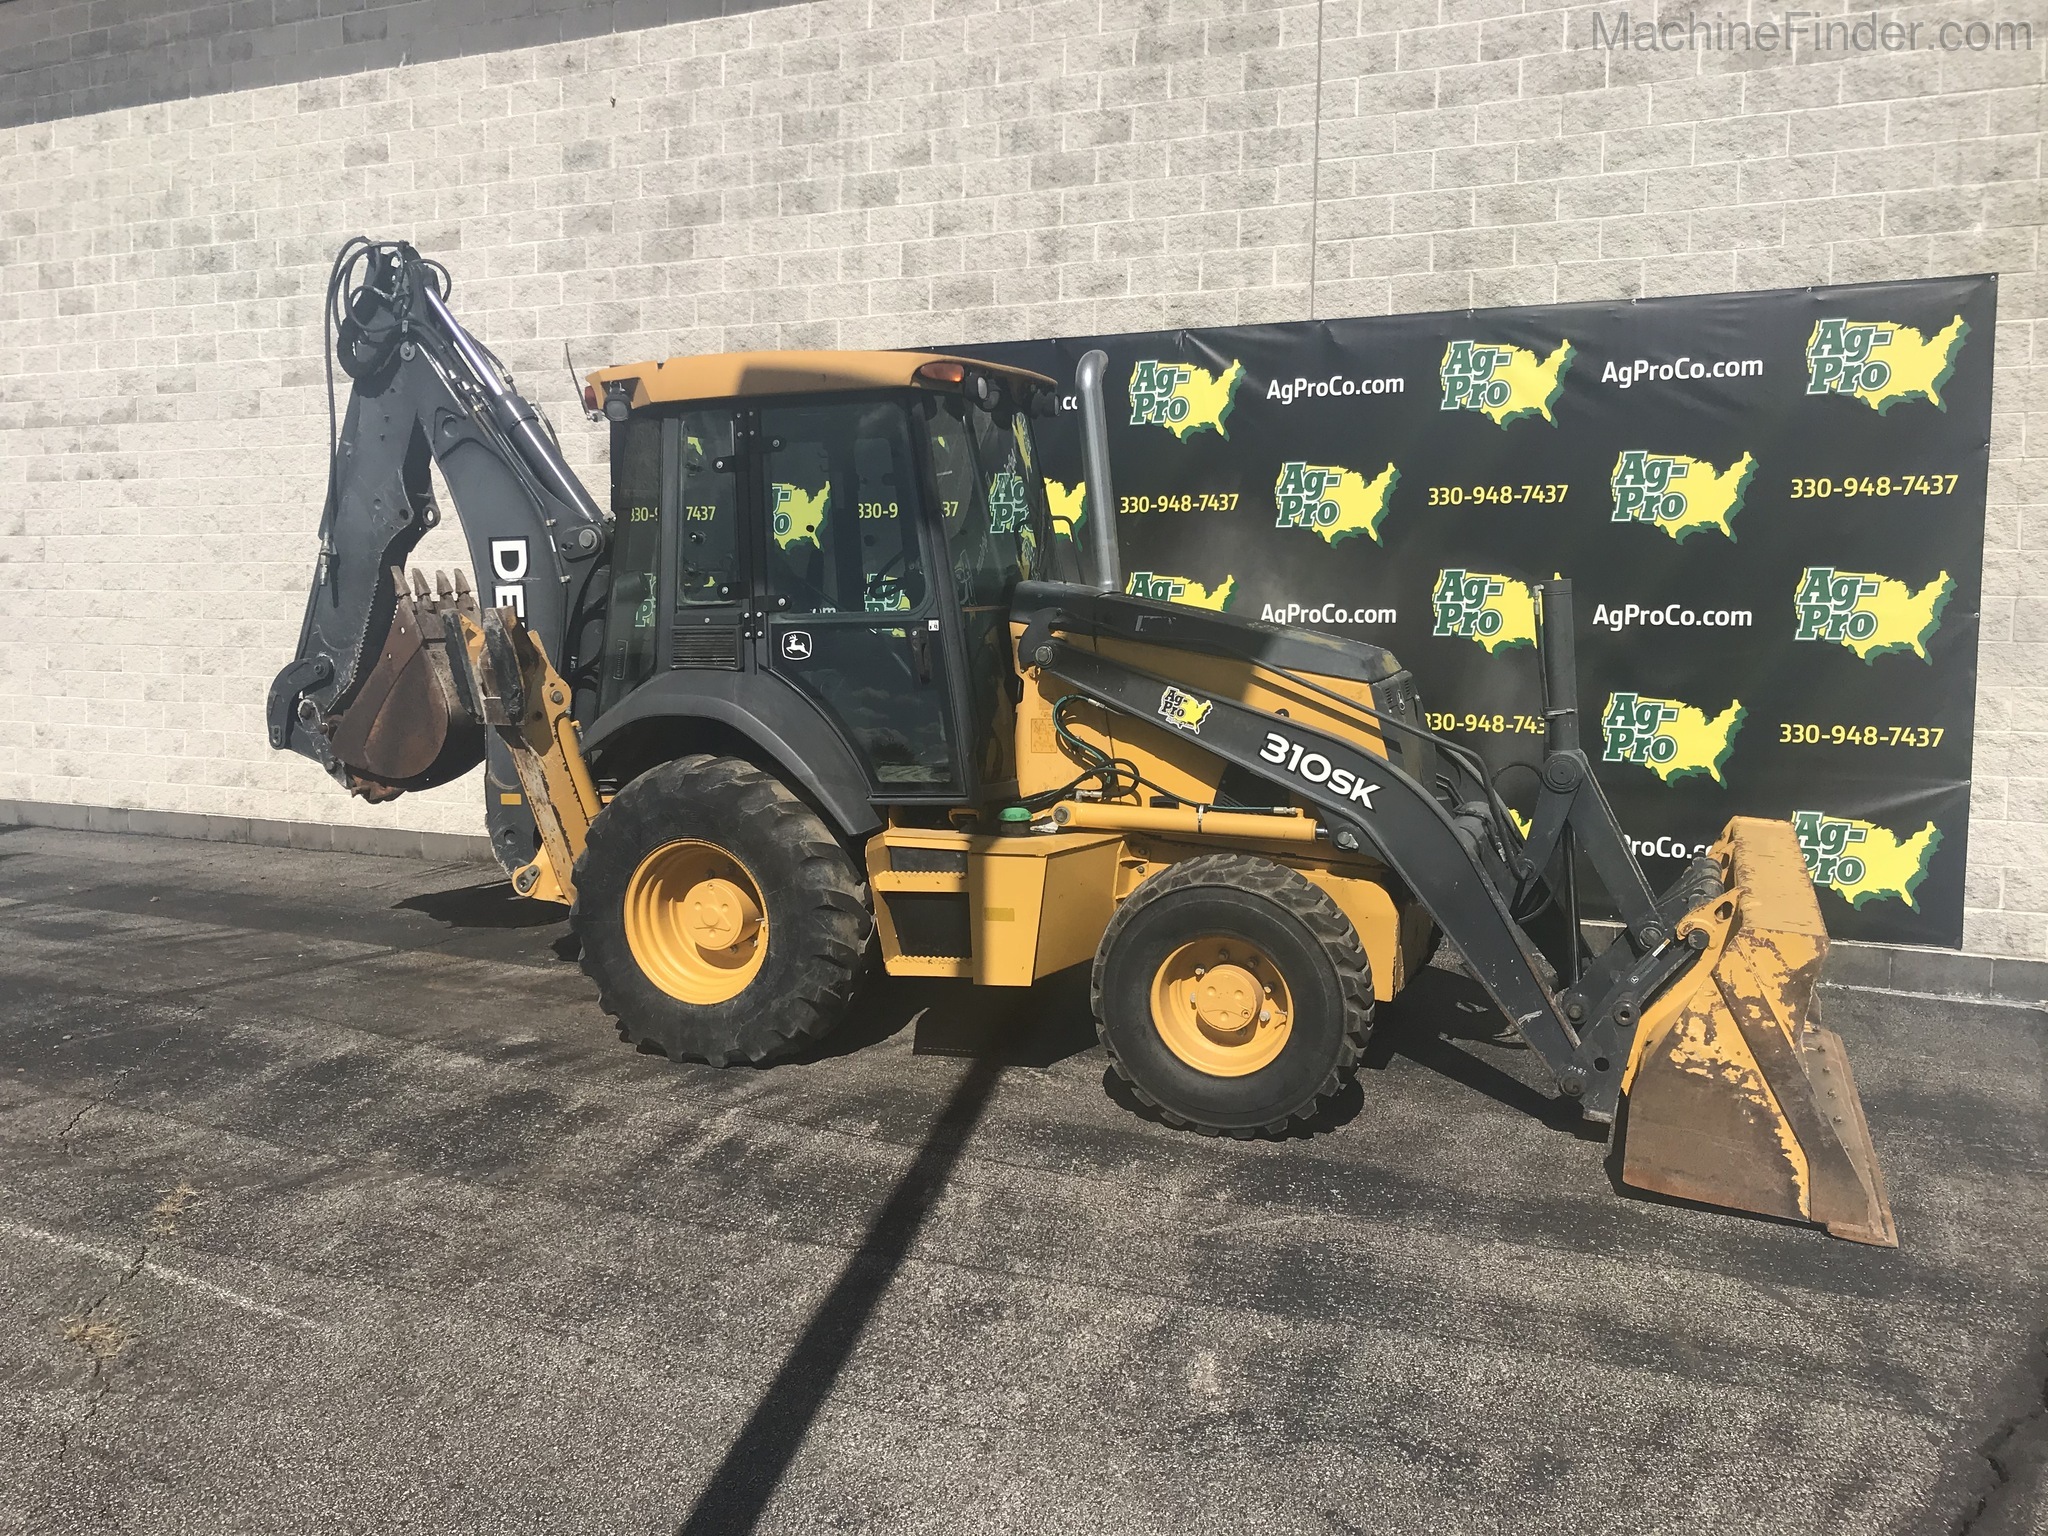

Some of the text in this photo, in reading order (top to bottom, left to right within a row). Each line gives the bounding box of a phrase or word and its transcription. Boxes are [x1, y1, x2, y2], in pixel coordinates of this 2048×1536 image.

[1809, 318, 1891, 362] Ag-
[1442, 340, 1511, 378] Ag-
[1602, 357, 1764, 389] AgProCo.com
[1806, 357, 1891, 395] Pro
[1131, 360, 1190, 399] Ag-
[1266, 375, 1404, 404] AgProCo.com
[1440, 373, 1510, 410] Pro
[1130, 392, 1189, 425] Pro
[1277, 462, 1340, 498] Ag-
[1616, 450, 1688, 492] Ag-
[1790, 474, 1959, 499] 330-948-7437
[1120, 493, 1239, 514] 330-948-7437
[1275, 495, 1339, 528] Pro
[1428, 484, 1569, 506] 330-948-7437
[1611, 487, 1686, 522] Pro
[1130, 572, 1184, 601] Ag-
[1435, 569, 1503, 606] Ag-
[1798, 567, 1878, 609] Ag-
[1260, 603, 1397, 626] AgProCo.com
[1433, 602, 1502, 636] Pro
[1592, 603, 1753, 632] AgProCo.com
[1795, 604, 1877, 640] Pro
[1161, 700, 1185, 717] Pro
[1606, 693, 1677, 732] Ag-
[1603, 727, 1677, 764] Pro
[1779, 723, 1945, 748] 330-948-7437
[1259, 732, 1381, 809] 310SK
[1795, 811, 1867, 856] Ag-
